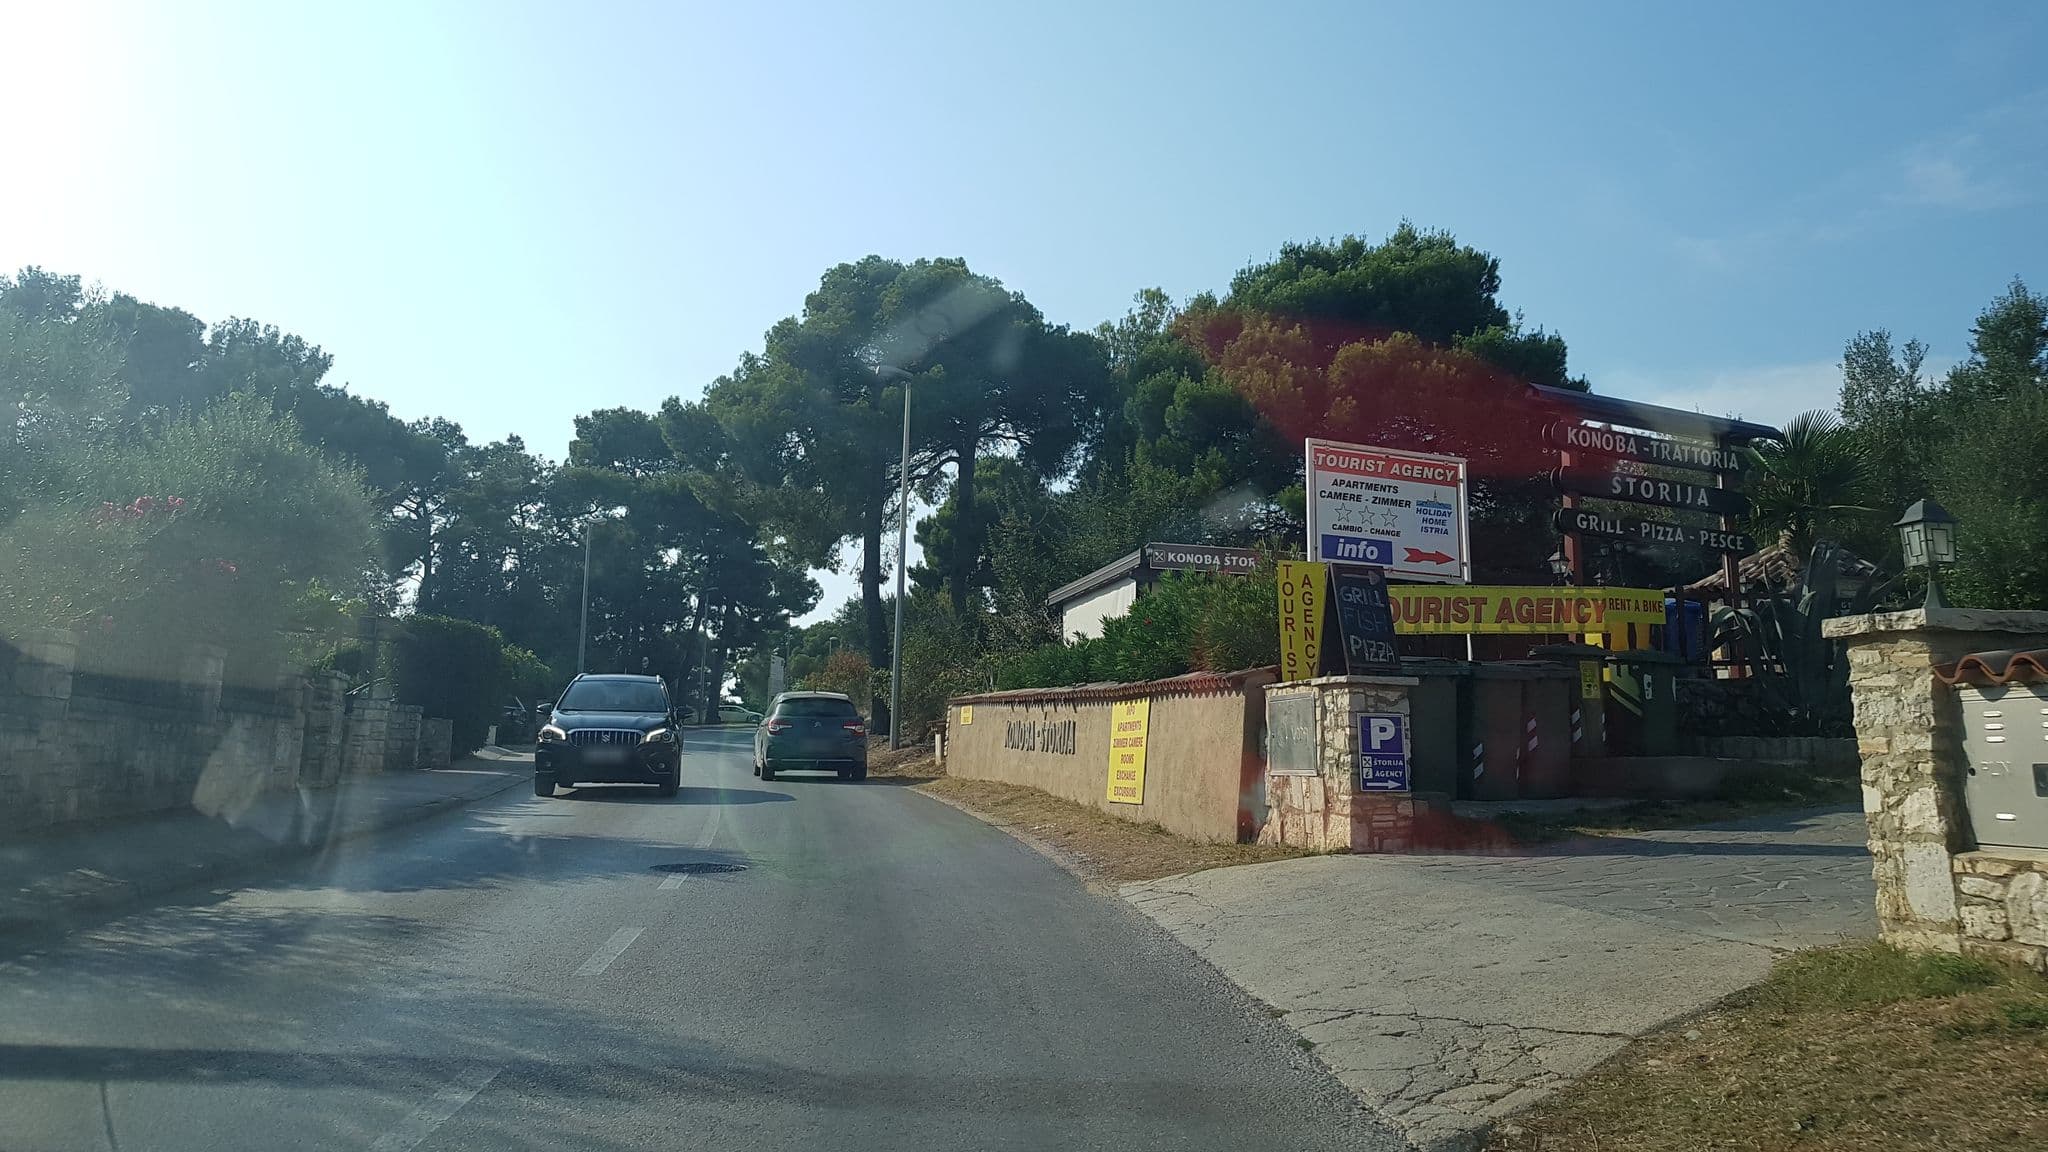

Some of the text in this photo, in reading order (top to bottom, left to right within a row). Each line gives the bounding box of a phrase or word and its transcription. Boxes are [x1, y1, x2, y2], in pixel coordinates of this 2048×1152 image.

[1567, 427, 1638, 455] KONOBA
[1316, 452, 1456, 482] TOURIST AGENCY
[1331, 478, 1400, 494] APARTMENTS
[1319, 490, 1362, 503] CAMERE
[1371, 496, 1412, 508] ZIMMER
[1415, 507, 1453, 518] HOLIDAY
[1421, 517, 1448, 526] HOME
[1331, 523, 1363, 533] CAMBIO
[1370, 527, 1402, 537] CHANGE
[1420, 525, 1449, 536] ISTRIA
[1576, 513, 1624, 535] GRILL
[1640, 522, 1684, 543] PIZZA
[1701, 530, 1745, 551] PESCE
[1167, 552, 1256, 567] KONOBA ŠTOR
[1336, 538, 1378, 560] info
[1388, 596, 1663, 624] OURIST AGENCY RENT A BIKE
[1282, 564, 1297, 682] TOURIST
[1301, 573, 1317, 677] AGENCY
[1349, 634, 1396, 664] PIZZA
[1370, 718, 1396, 750] P
[1374, 770, 1403, 778] AGENCY
